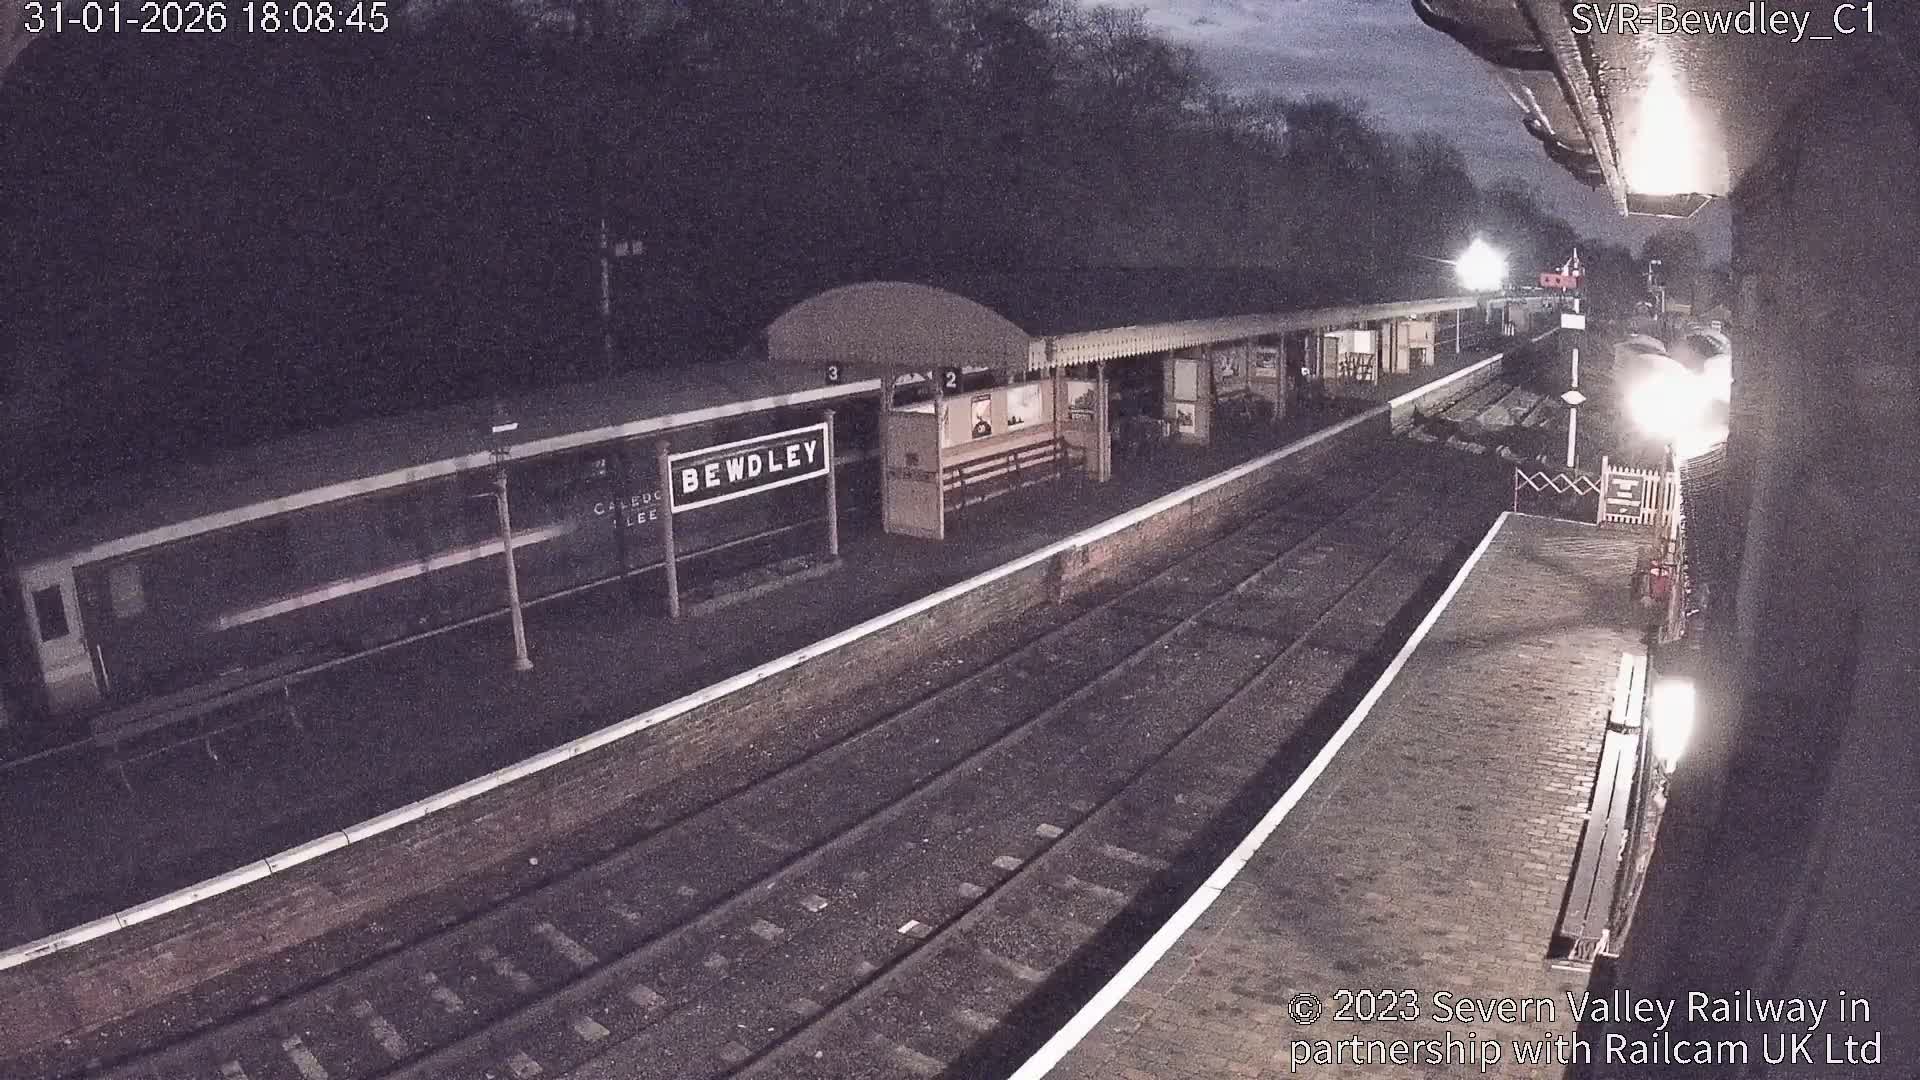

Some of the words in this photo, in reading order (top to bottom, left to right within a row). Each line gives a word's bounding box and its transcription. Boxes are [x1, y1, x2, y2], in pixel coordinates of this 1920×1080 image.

[828, 366, 838, 381] 3
[946, 371, 958, 388] 2
[681, 439, 817, 494] BEWDLEY
